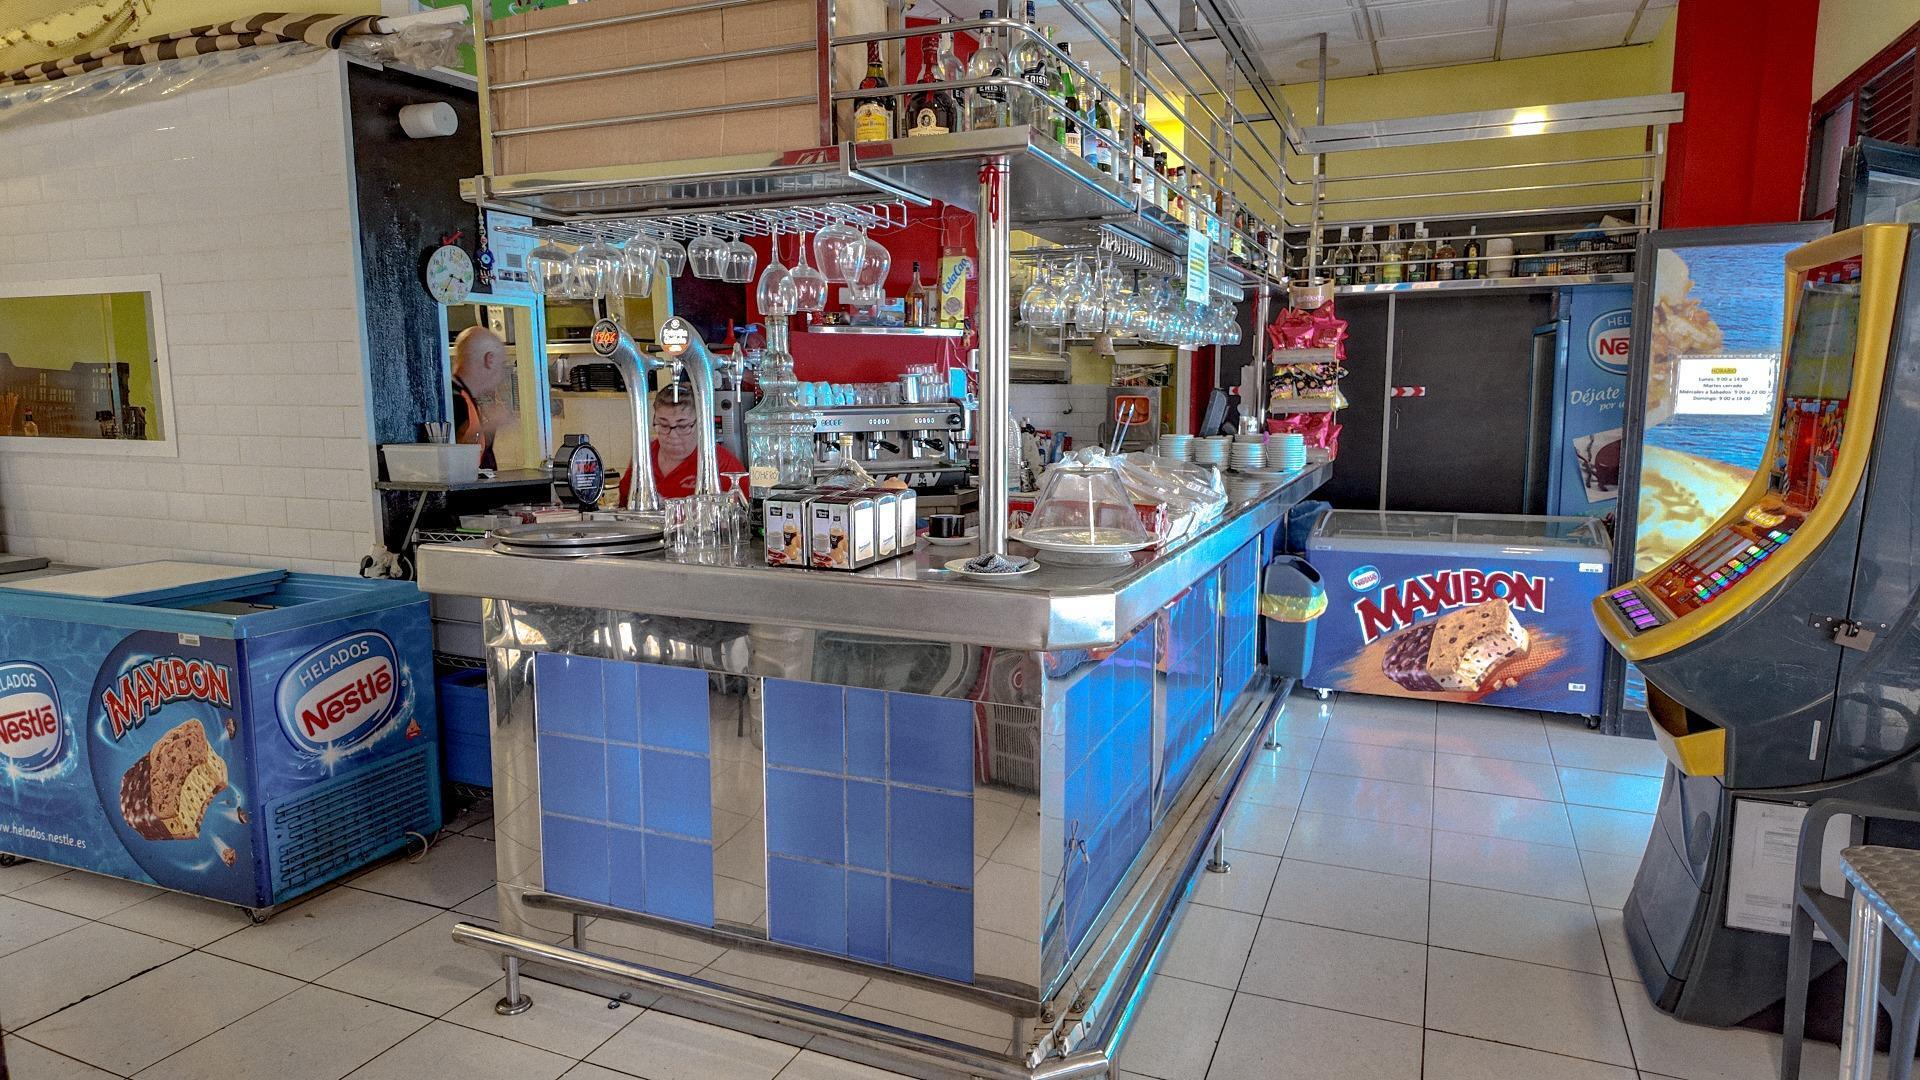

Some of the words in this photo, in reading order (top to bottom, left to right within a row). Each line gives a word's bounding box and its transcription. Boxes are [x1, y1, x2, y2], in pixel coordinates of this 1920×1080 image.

[943, 258, 971, 294] ColaCao
[595, 330, 618, 344] 1906
[1711, 367, 1737, 375] HORARIO
[1570, 386, 1620, 406] Déjate
[1354, 568, 1546, 645] MAXIBON
[299, 640, 370, 687] HELADOS
[0, 672, 37, 693] LADOS
[102, 657, 232, 740] MAXIBON
[302, 663, 392, 737] Nestlé
